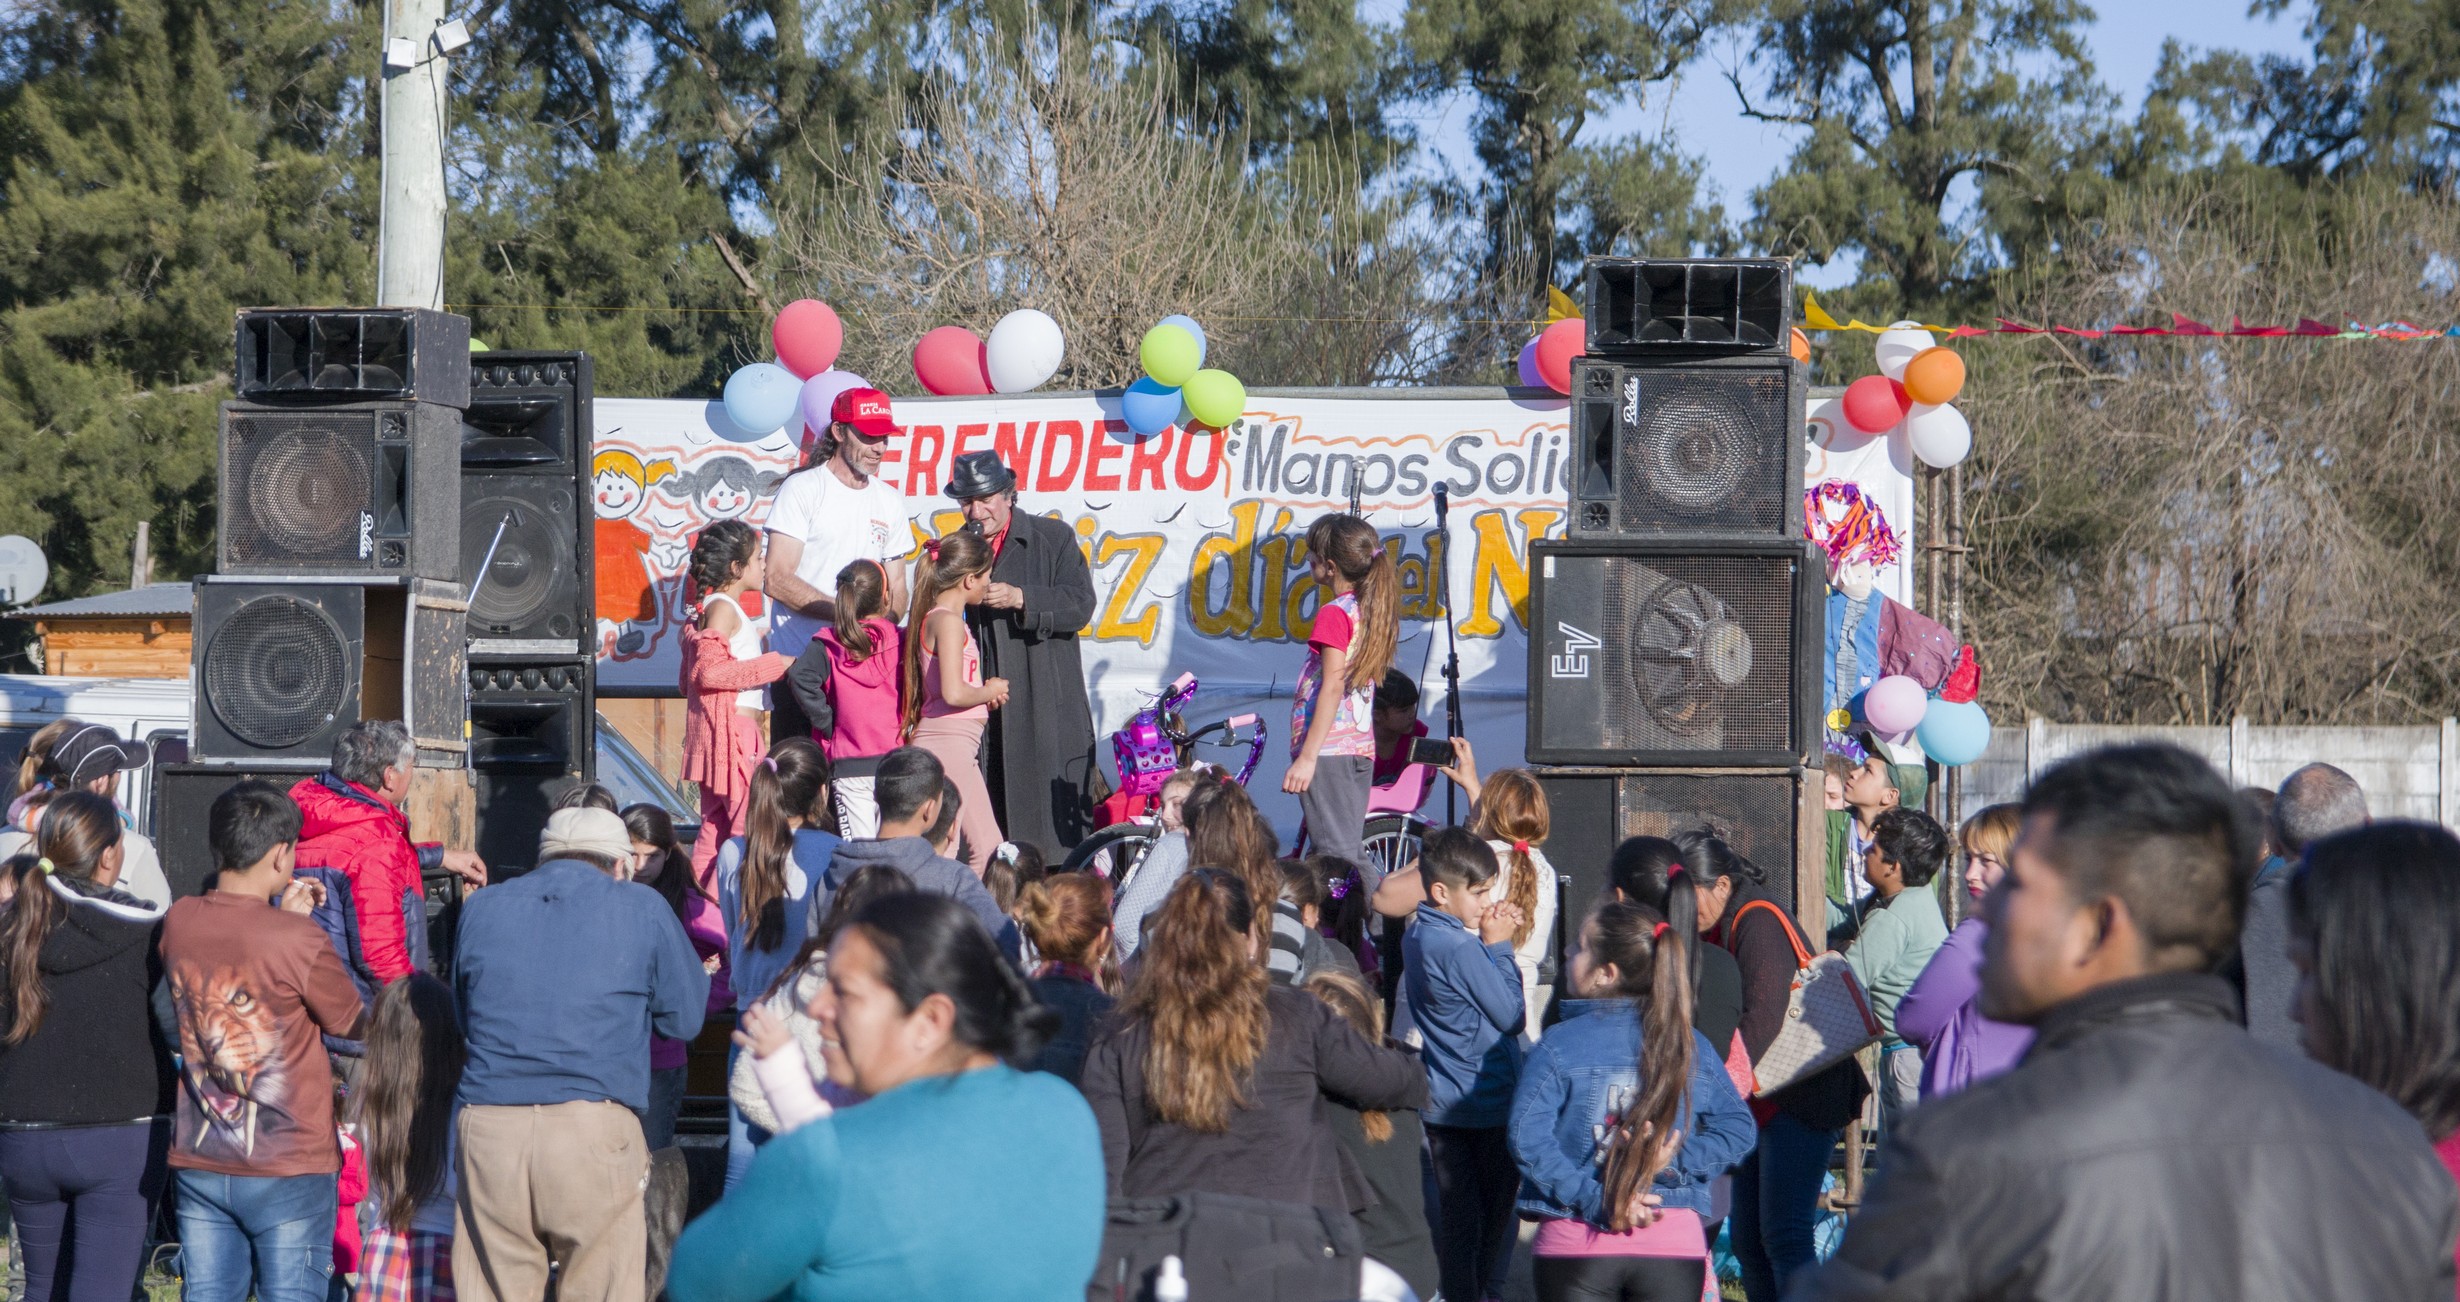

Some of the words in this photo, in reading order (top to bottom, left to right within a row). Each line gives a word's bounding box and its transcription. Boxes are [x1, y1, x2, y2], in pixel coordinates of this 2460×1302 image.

[860, 407, 871, 416] LA
[799, 417, 1223, 496] ERENDERO
[1445, 432, 1569, 497] Soli
[1552, 621, 1601, 677] EV
